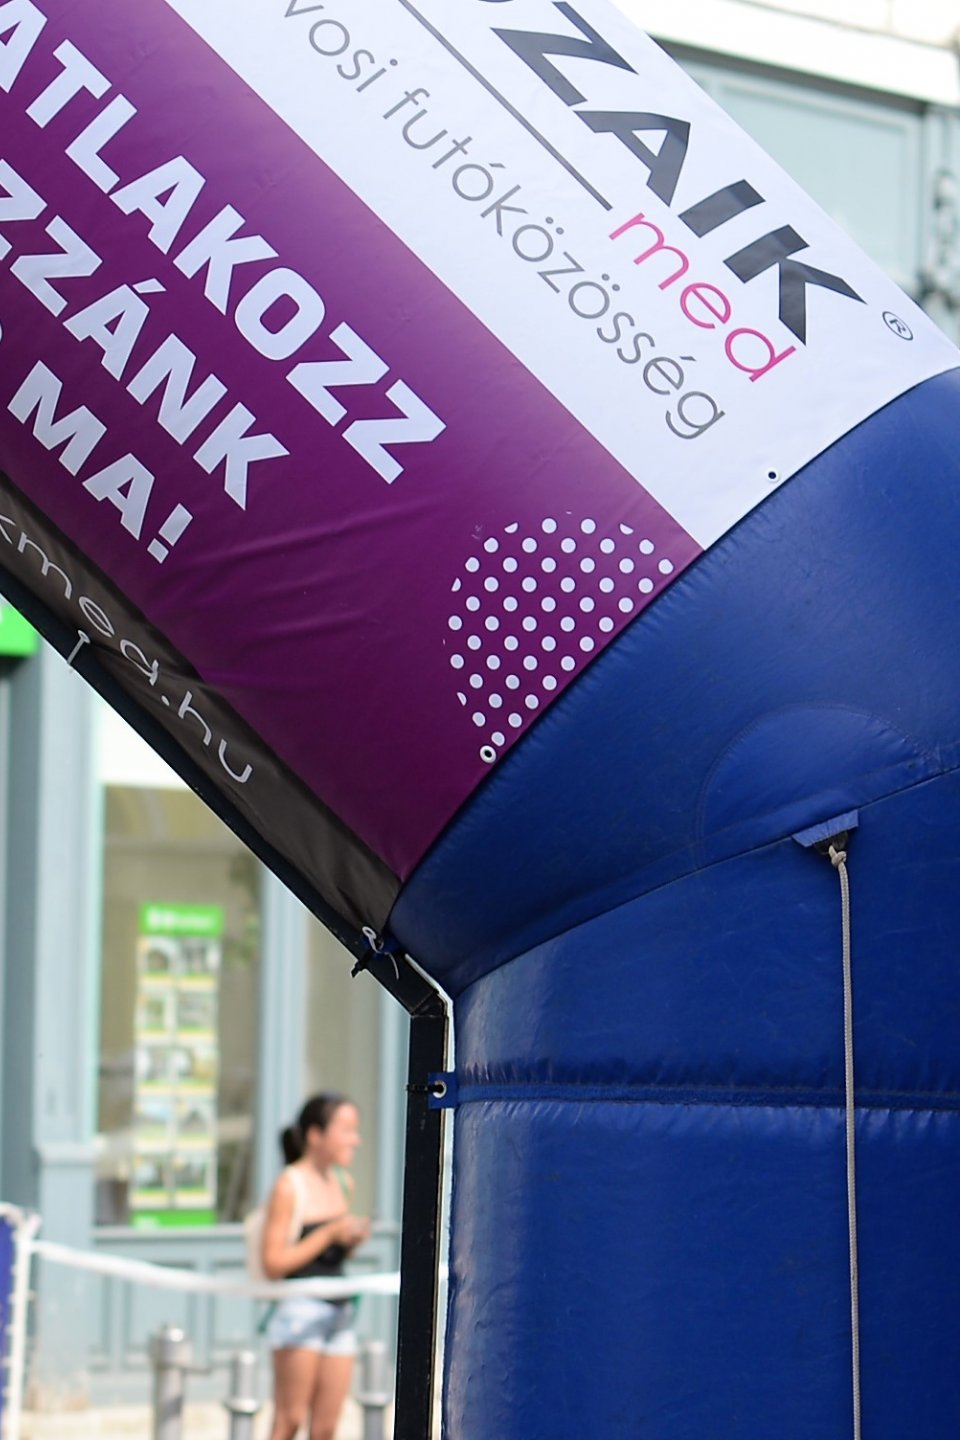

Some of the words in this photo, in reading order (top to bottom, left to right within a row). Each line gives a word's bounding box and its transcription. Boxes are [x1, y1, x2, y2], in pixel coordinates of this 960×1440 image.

[382, 87, 725, 440] futóközösség
[488, 0, 868, 345] ZAIK
[608, 213, 796, 382] med
[7, 360, 193, 564] MA!
